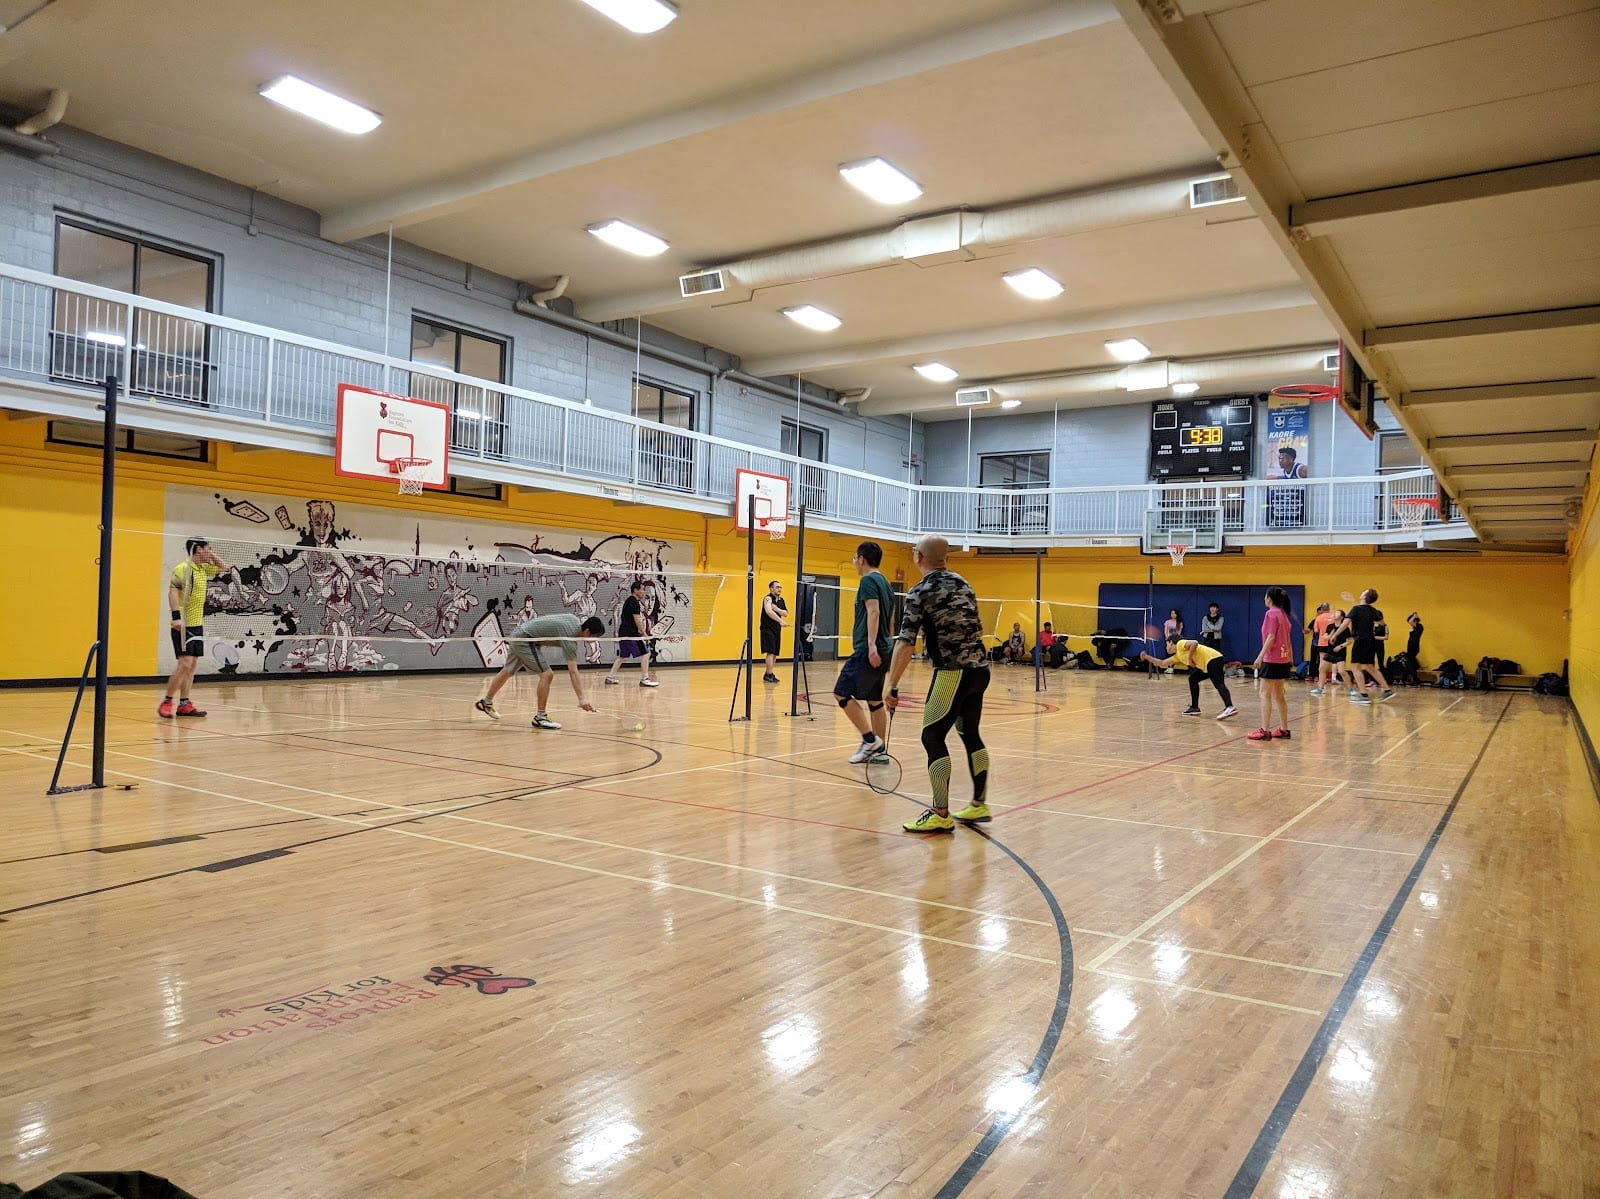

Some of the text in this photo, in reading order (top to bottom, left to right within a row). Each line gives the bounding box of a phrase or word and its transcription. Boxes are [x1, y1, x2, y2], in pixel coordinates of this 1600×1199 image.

[1229, 398, 1250, 406] GUEST
[1277, 435, 1308, 448] GRAY
[200, 982, 415, 1046] Foundation
[264, 976, 392, 1014] for Kids
[306, 989, 439, 1031] Raptors
